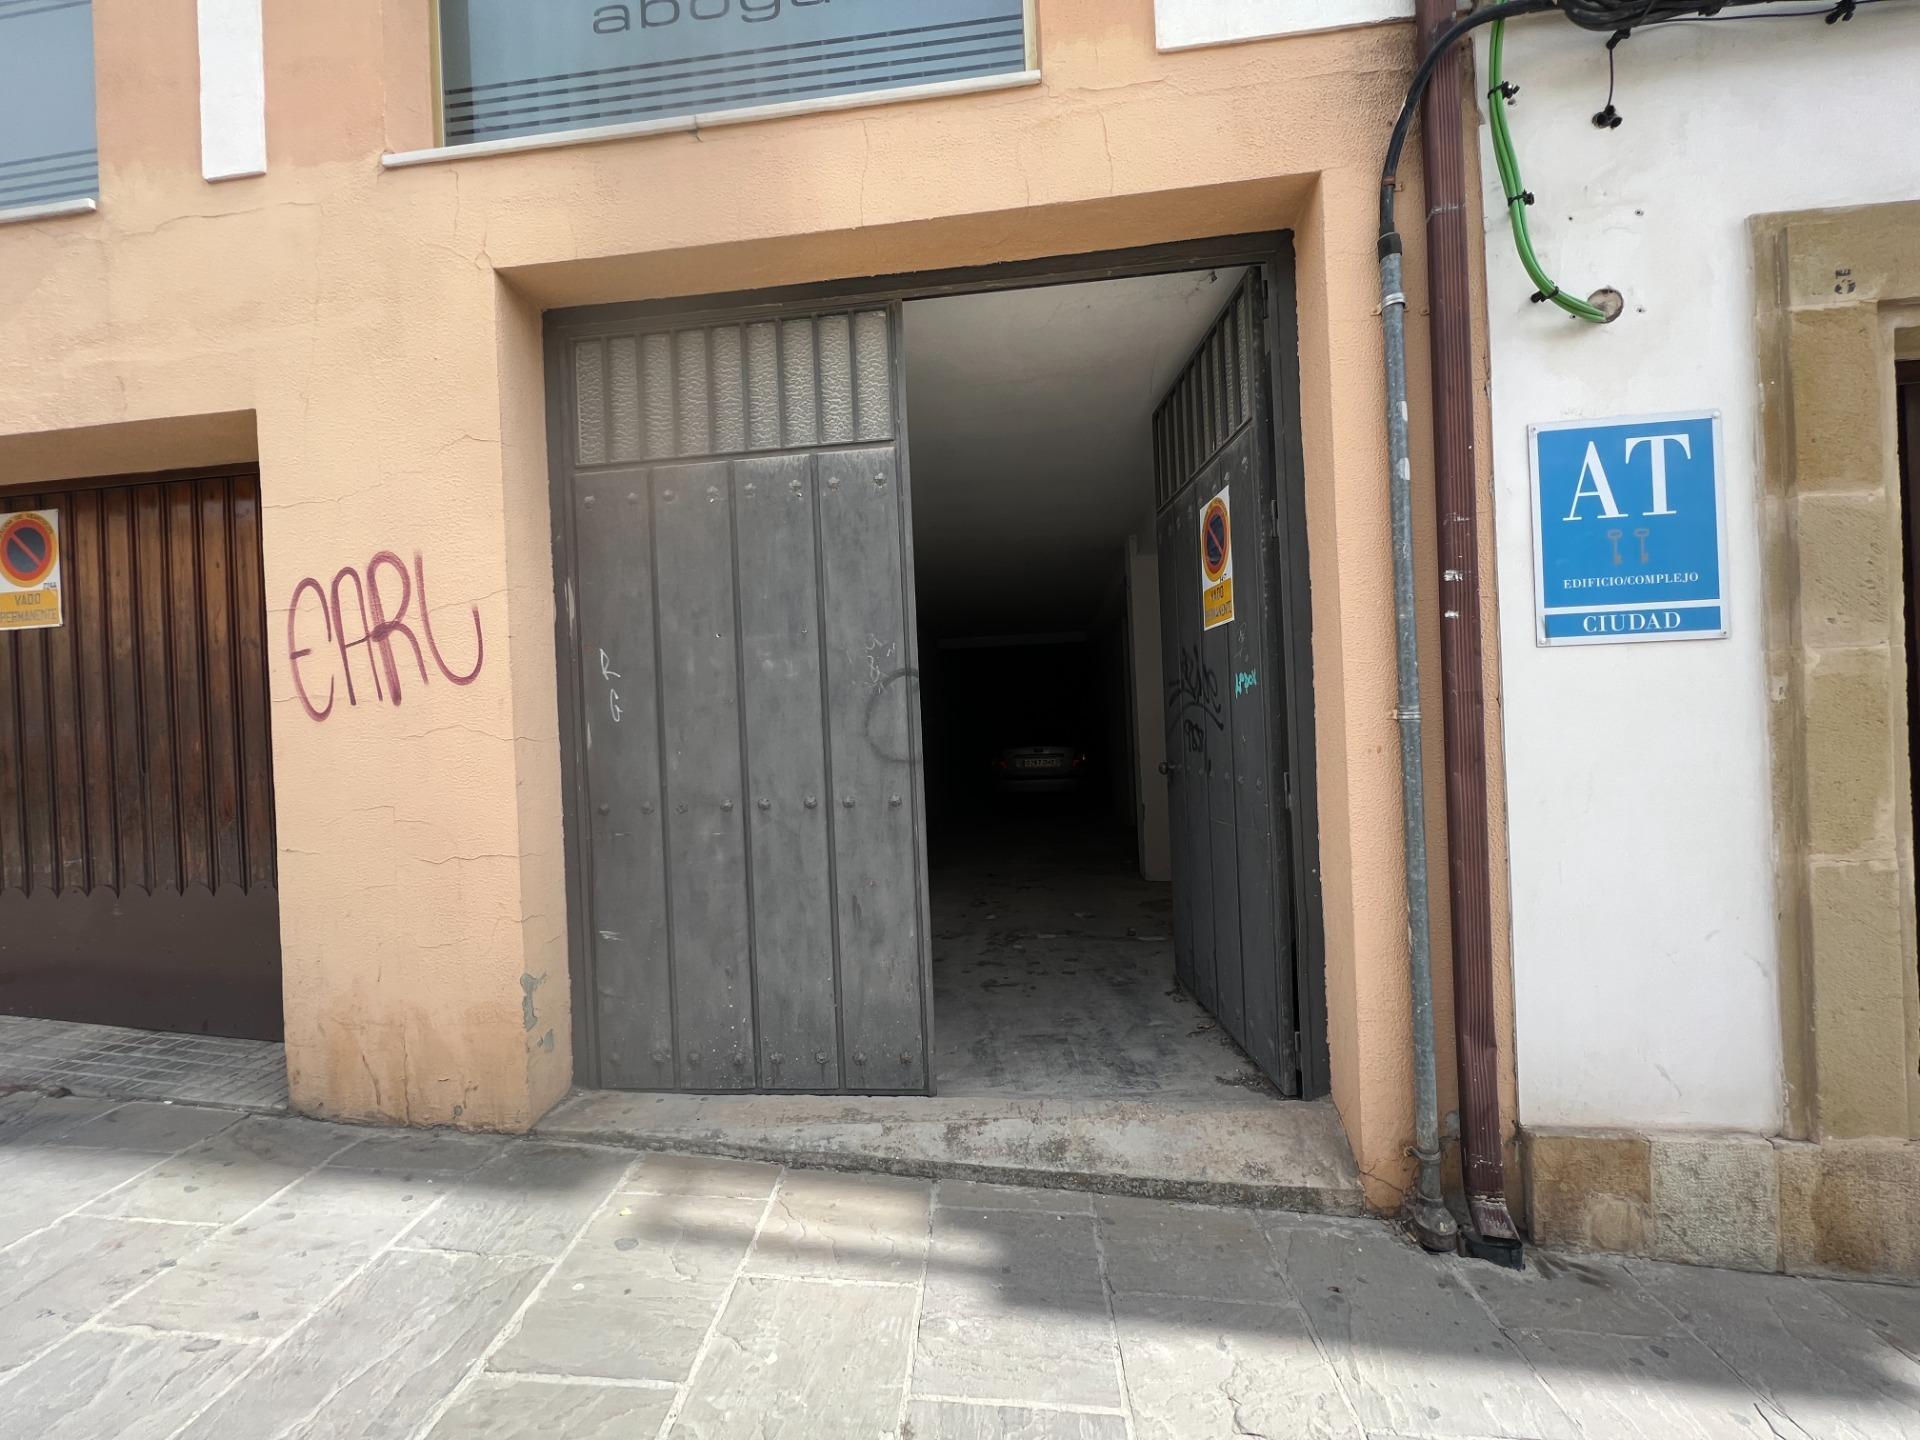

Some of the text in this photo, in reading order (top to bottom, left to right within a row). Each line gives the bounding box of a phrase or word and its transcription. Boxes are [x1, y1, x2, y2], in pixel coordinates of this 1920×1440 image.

[593, 0, 831, 34] abog
[1562, 433, 1692, 521] AT
[1563, 571, 1699, 589] EDIFICIO/COMPLEJO
[15, 593, 41, 606] VADO
[1583, 611, 1681, 633] CIUDAD
